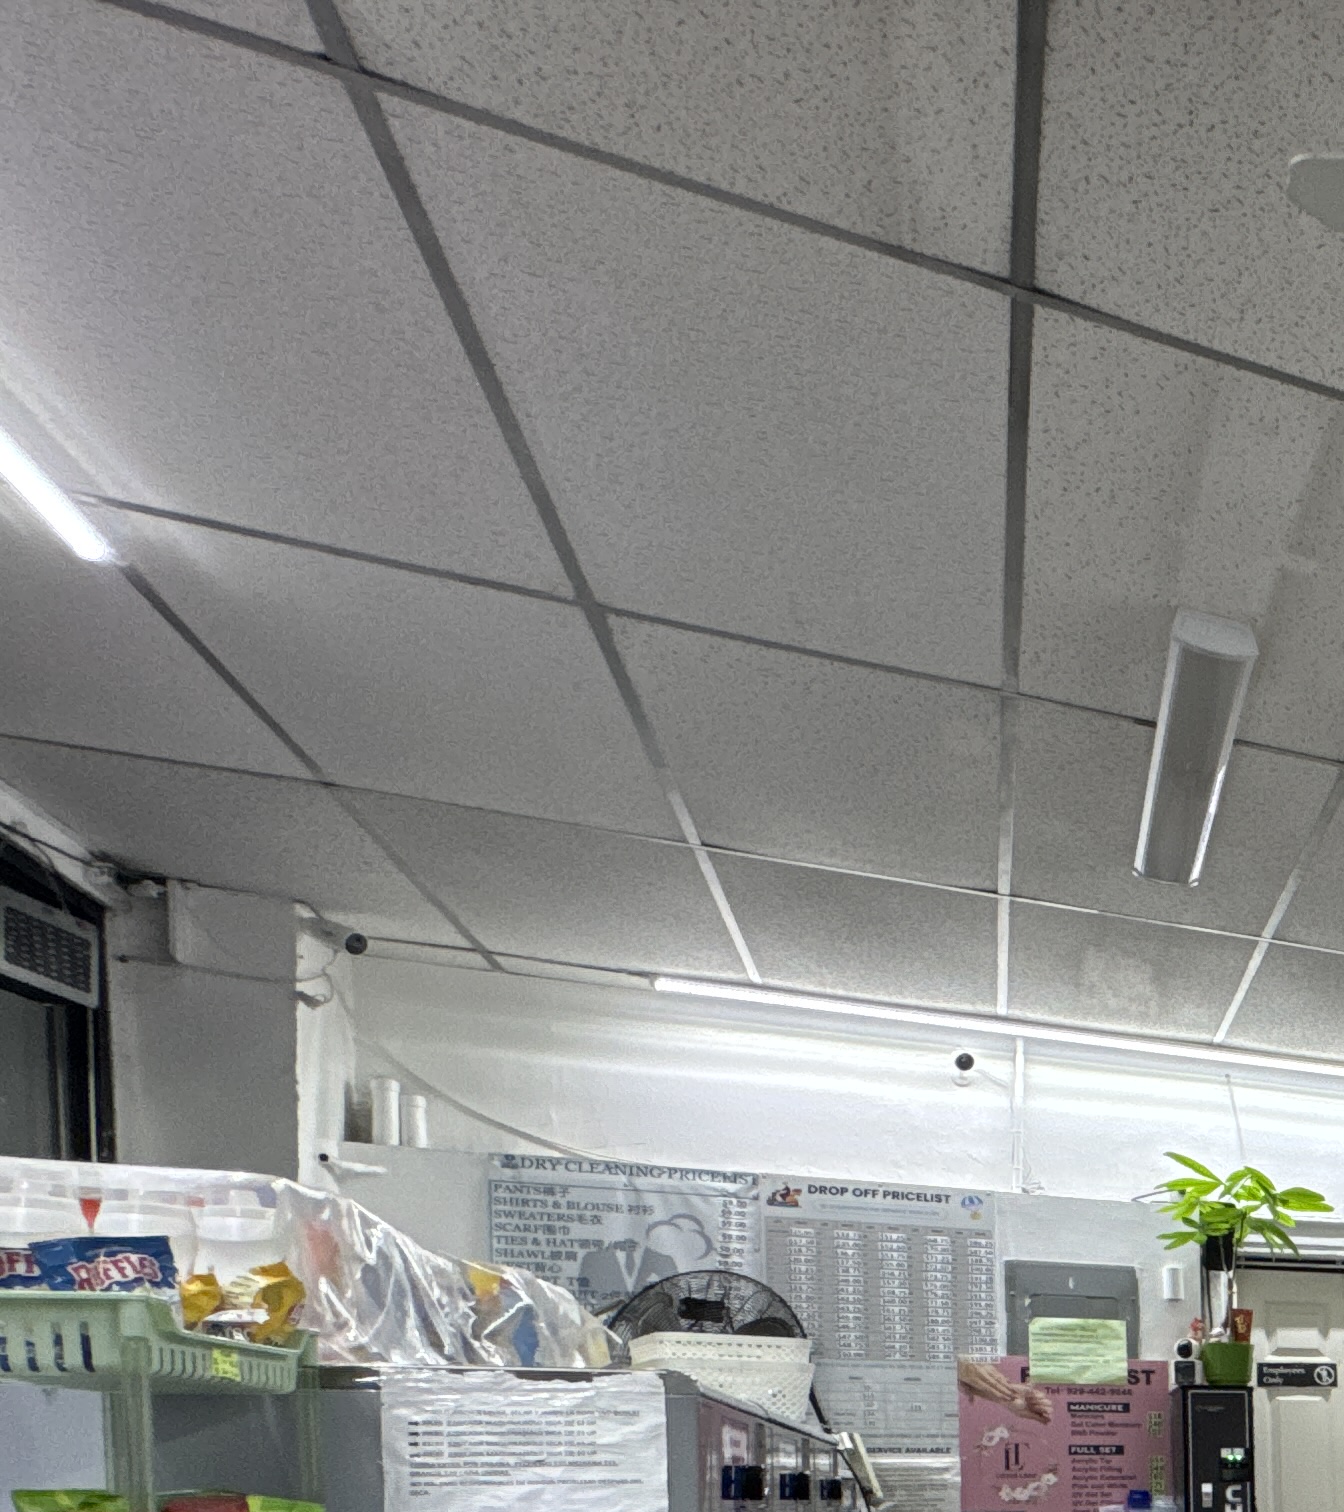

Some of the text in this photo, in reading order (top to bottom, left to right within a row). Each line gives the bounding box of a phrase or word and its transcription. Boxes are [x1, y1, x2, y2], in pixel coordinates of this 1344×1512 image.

[520, 1157, 760, 1186] DRY CLEANING PRICELIST
[807, 1184, 952, 1204] DROP OFF PRICELIST
[494, 1197, 625, 1215] SHIRTS & BLOUSE
[494, 1235, 528, 1246] TIES
[67, 1252, 164, 1291] RUFFLES
[1070, 1403, 1124, 1412] MANICURE
[1071, 1446, 1096, 1454] FULL
